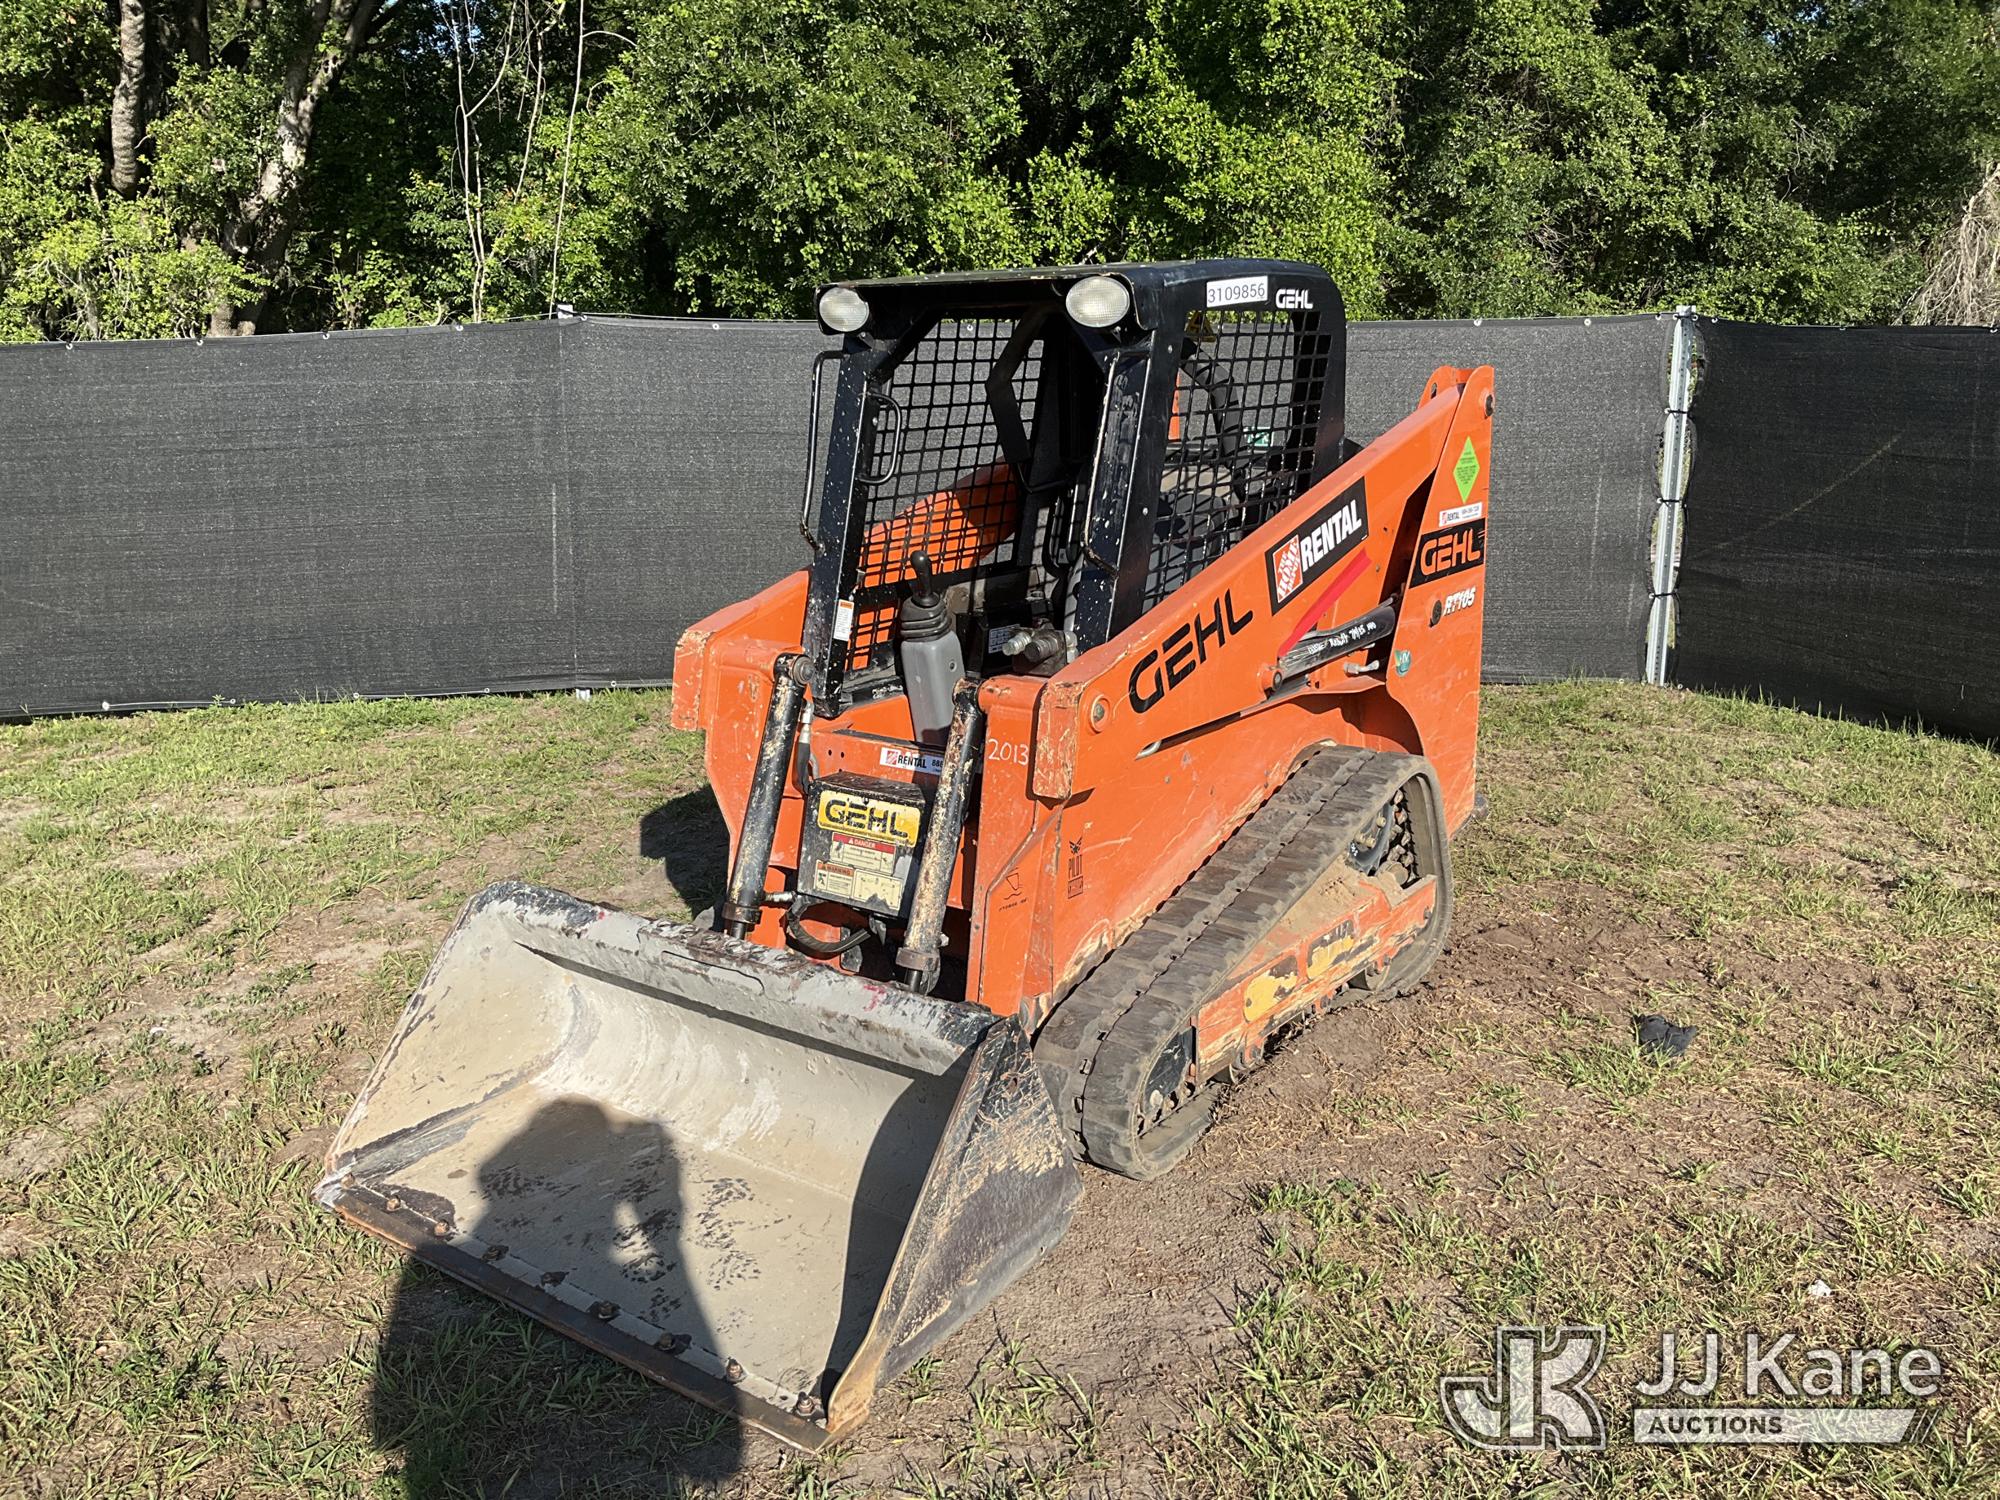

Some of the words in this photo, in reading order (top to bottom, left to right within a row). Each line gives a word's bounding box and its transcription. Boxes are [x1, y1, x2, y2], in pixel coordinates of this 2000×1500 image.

[1208, 283, 1265, 304] 3109856
[1275, 288, 1314, 309] GEHL
[1300, 499, 1362, 573] RENTAL
[1420, 528, 1481, 576] GEHL
[1443, 586, 1476, 616] RT105
[1128, 588, 1253, 714] GEHL
[897, 754, 927, 769] RENTAL
[988, 738, 1029, 766] 2013
[825, 799, 909, 839] GEHL
[854, 839, 876, 849] DANGER
